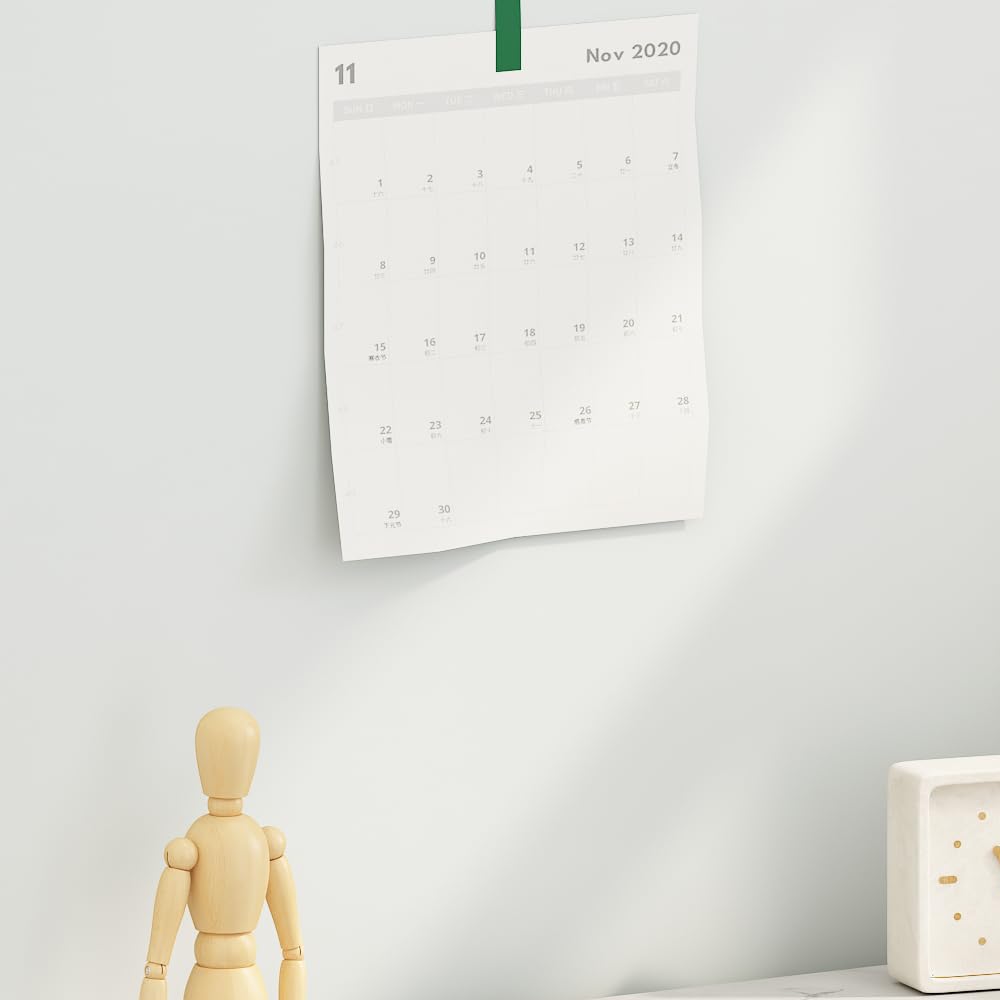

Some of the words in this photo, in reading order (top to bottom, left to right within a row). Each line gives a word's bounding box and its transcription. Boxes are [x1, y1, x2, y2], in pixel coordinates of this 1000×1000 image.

[586, 47, 625, 64] Nov
[631, 40, 681, 60] 2020
[334, 62, 356, 86] 11
[377, 178, 383, 188] 1
[426, 174, 434, 183] 2
[477, 169, 484, 179] 3
[526, 164, 534, 174] 4
[576, 159, 583, 170] 5
[624, 155, 632, 165] 6
[672, 151, 679, 161] 7
[379, 260, 387, 270] 8
[429, 256, 436, 265] 9
[473, 251, 487, 261] 10
[523, 247, 535, 257] 11
[573, 242, 585, 252] 12
[623, 237, 635, 247] 13
[671, 233, 684, 243] 14
[374, 342, 387, 352] 15
[423, 337, 437, 348] 16
[474, 332, 486, 343] 17
[523, 327, 536, 337] 18
[573, 323, 586, 333] 19
[622, 318, 635, 329] 20
[671, 313, 683, 324] 21
[379, 425, 393, 435] 22
[428, 420, 442, 431] 23
[479, 415, 492, 425] 24
[529, 410, 542, 421] 25
[579, 405, 592, 416] 26
[628, 400, 641, 411] 27
[677, 395, 690, 406] 28
[387, 509, 401, 520] 29
[438, 504, 451, 514] 30
